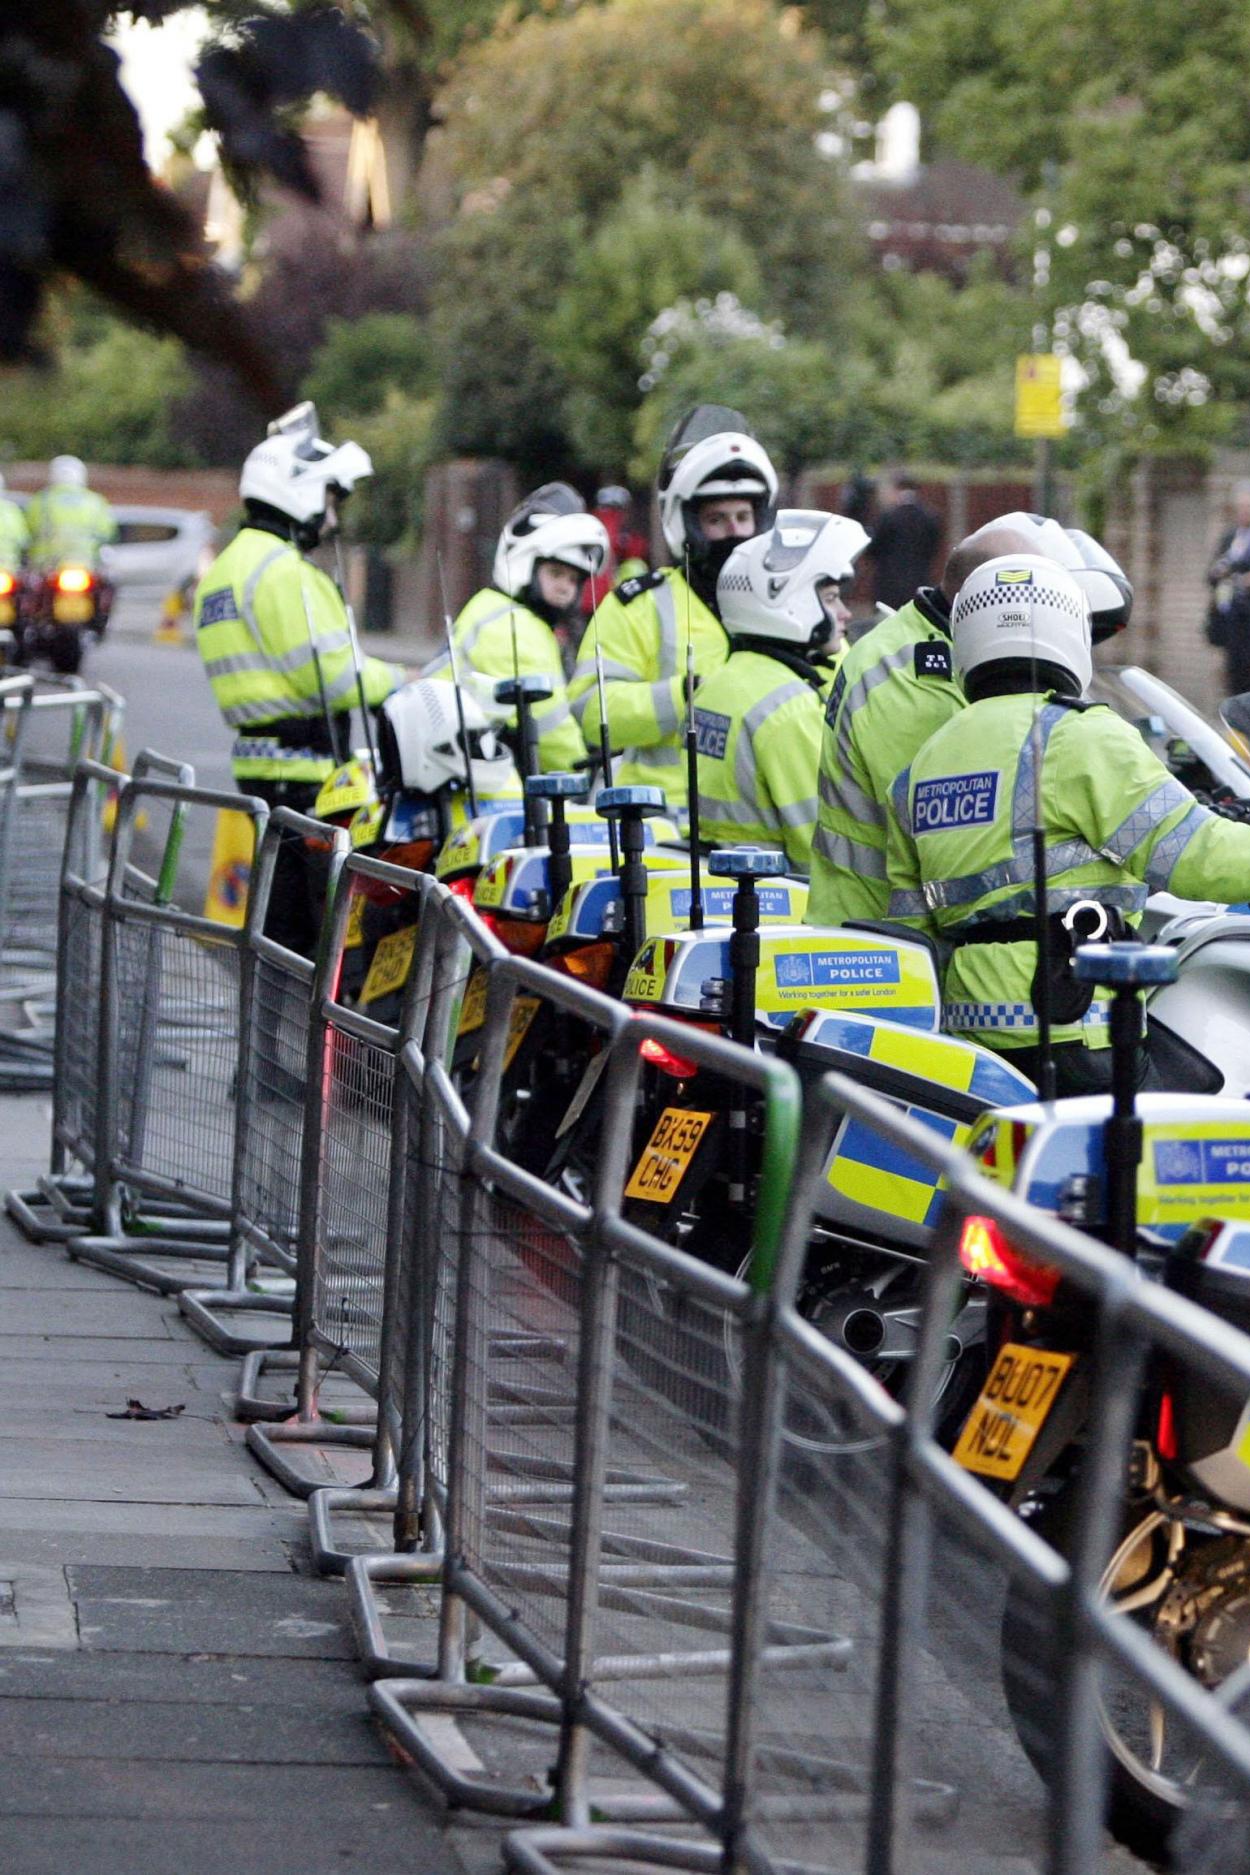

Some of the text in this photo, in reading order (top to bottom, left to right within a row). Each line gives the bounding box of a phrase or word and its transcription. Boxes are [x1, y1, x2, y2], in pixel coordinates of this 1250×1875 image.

[918, 776, 993, 799] METROPOLITAN
[916, 792, 991, 828] POLICE
[817, 955, 892, 966] METROPOLITAN
[829, 967, 884, 979] POLICE
[778, 989, 809, 999] Working
[809, 989, 838, 998] together
[839, 988, 849, 997] for
[872, 988, 896, 996] London
[650, 1115, 703, 1153] BX59
[638, 1154, 680, 1191] CHG
[986, 1356, 1061, 1410] BU07
